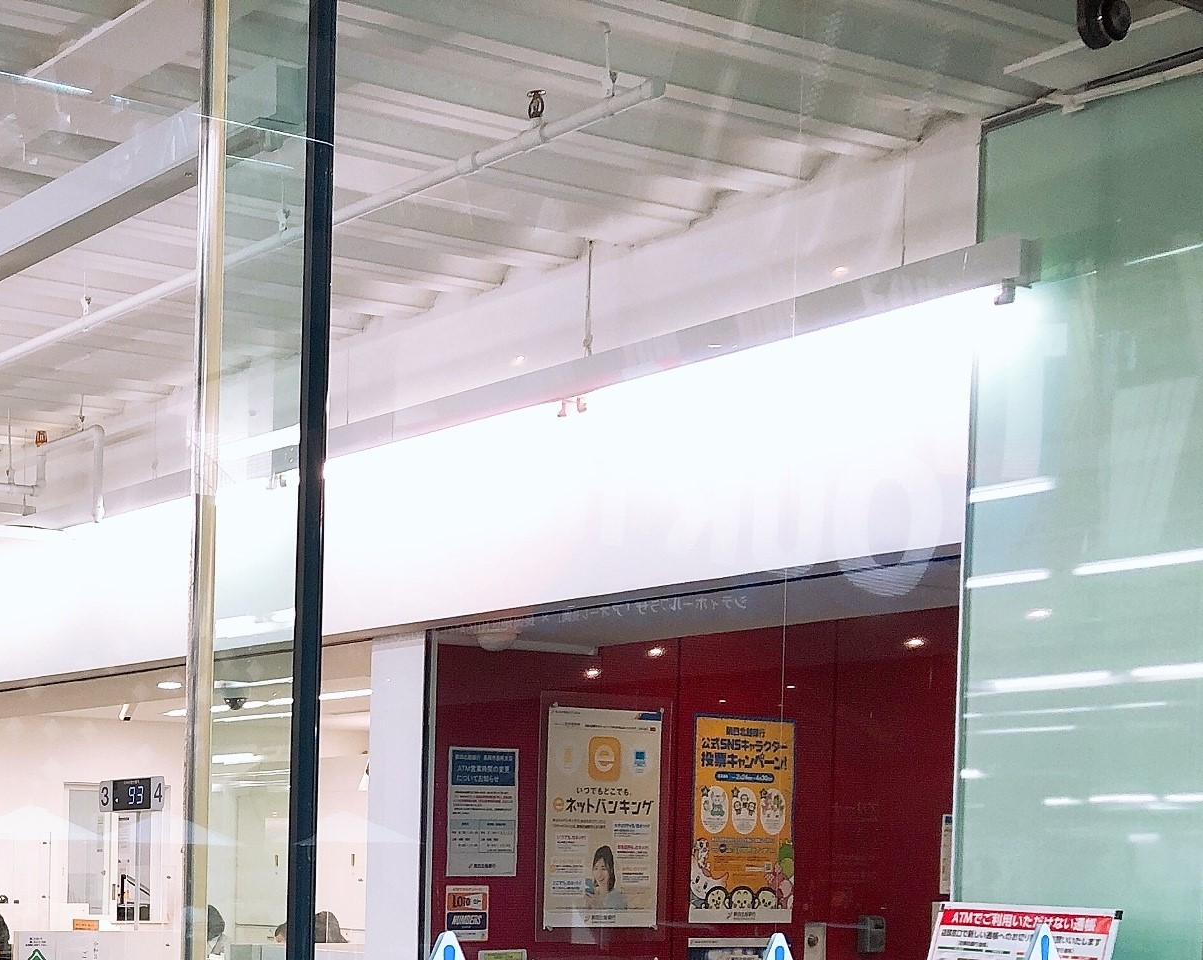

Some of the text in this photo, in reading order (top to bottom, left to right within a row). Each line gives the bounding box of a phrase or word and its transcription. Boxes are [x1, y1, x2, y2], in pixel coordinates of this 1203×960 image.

[701, 737, 788, 753] 公式SNSキャラクター
[101, 783, 163, 806] 3 93 4
